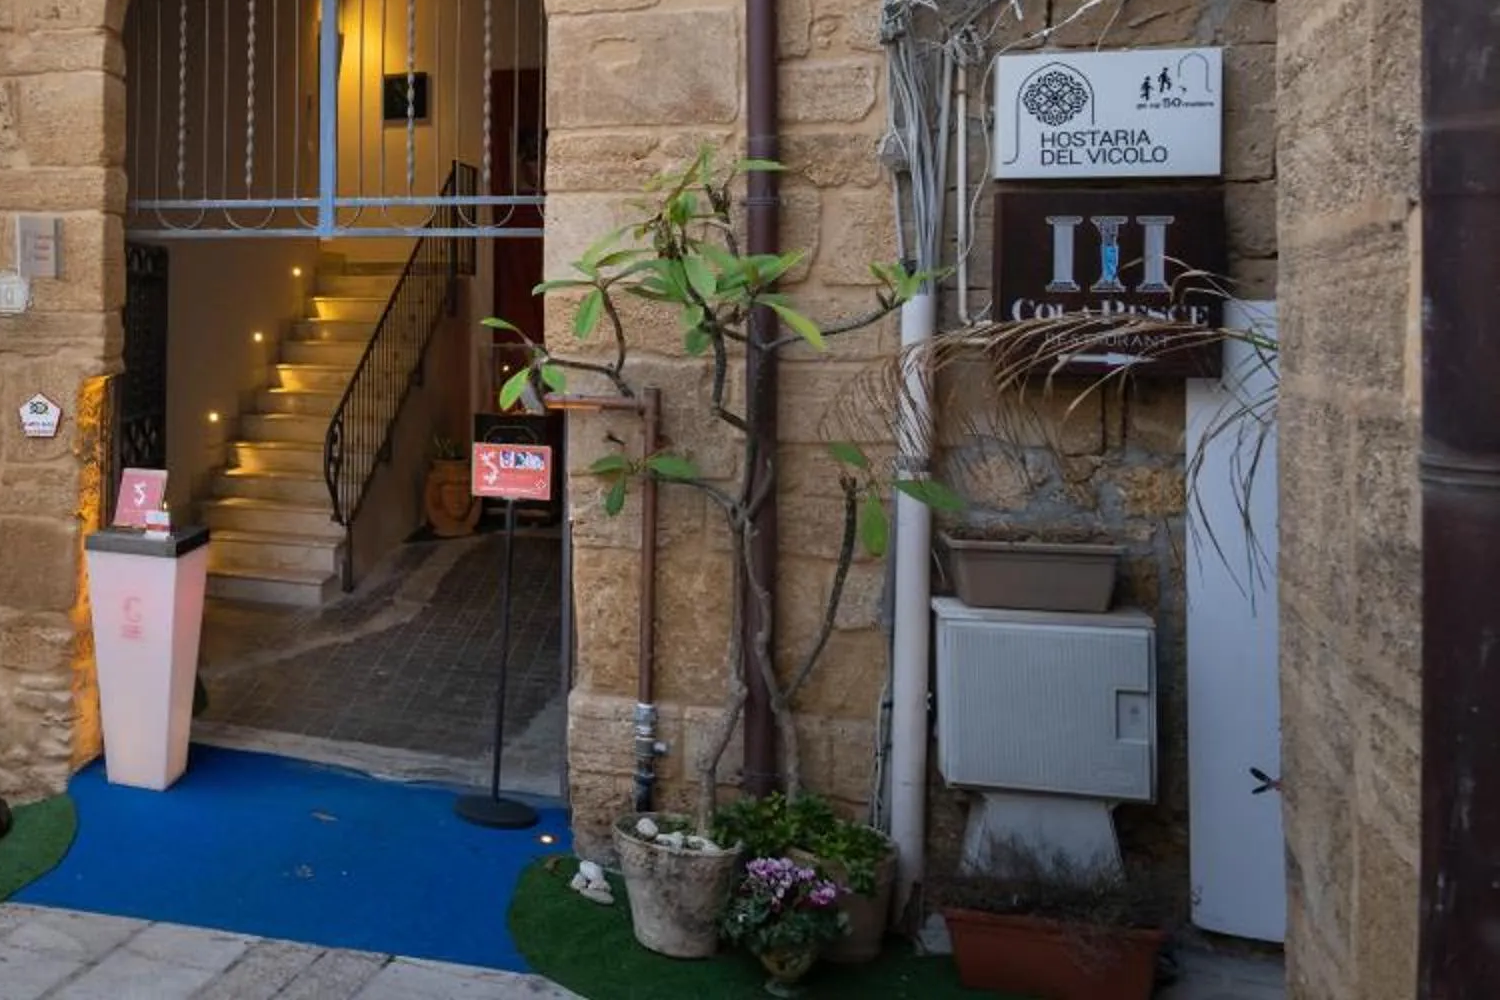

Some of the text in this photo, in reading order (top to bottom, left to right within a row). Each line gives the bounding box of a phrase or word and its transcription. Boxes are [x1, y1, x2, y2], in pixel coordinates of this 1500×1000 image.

[1041, 129, 1151, 148] HOSTARIA
[1041, 145, 1168, 165] DEL VICOLO
